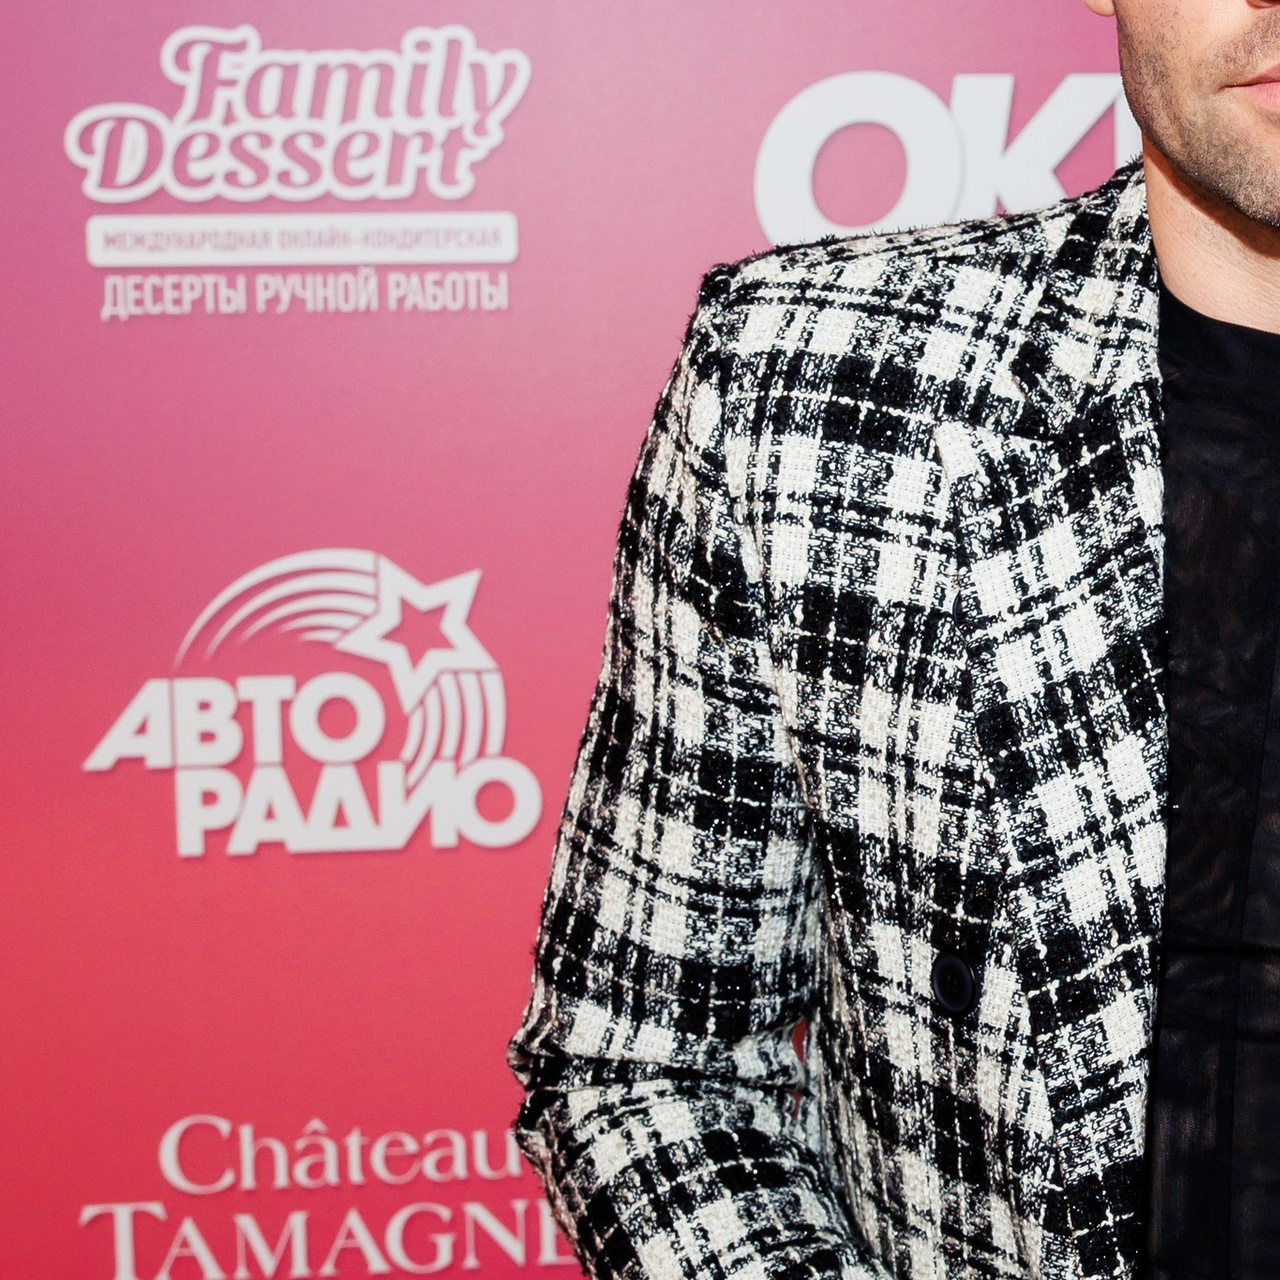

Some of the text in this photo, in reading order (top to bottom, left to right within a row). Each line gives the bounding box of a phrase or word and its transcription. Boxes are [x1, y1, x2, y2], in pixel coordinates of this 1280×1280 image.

[162, 24, 532, 148] Family
[64, 102, 488, 203] Dessert
[100, 267, 509, 321] ДЕСЕРТЫ РУЧНОЙ РАБОТЫ
[82, 672, 386, 772] АВТО
[177, 757, 543, 858] РАДИО
[158, 1114, 524, 1195] Château
